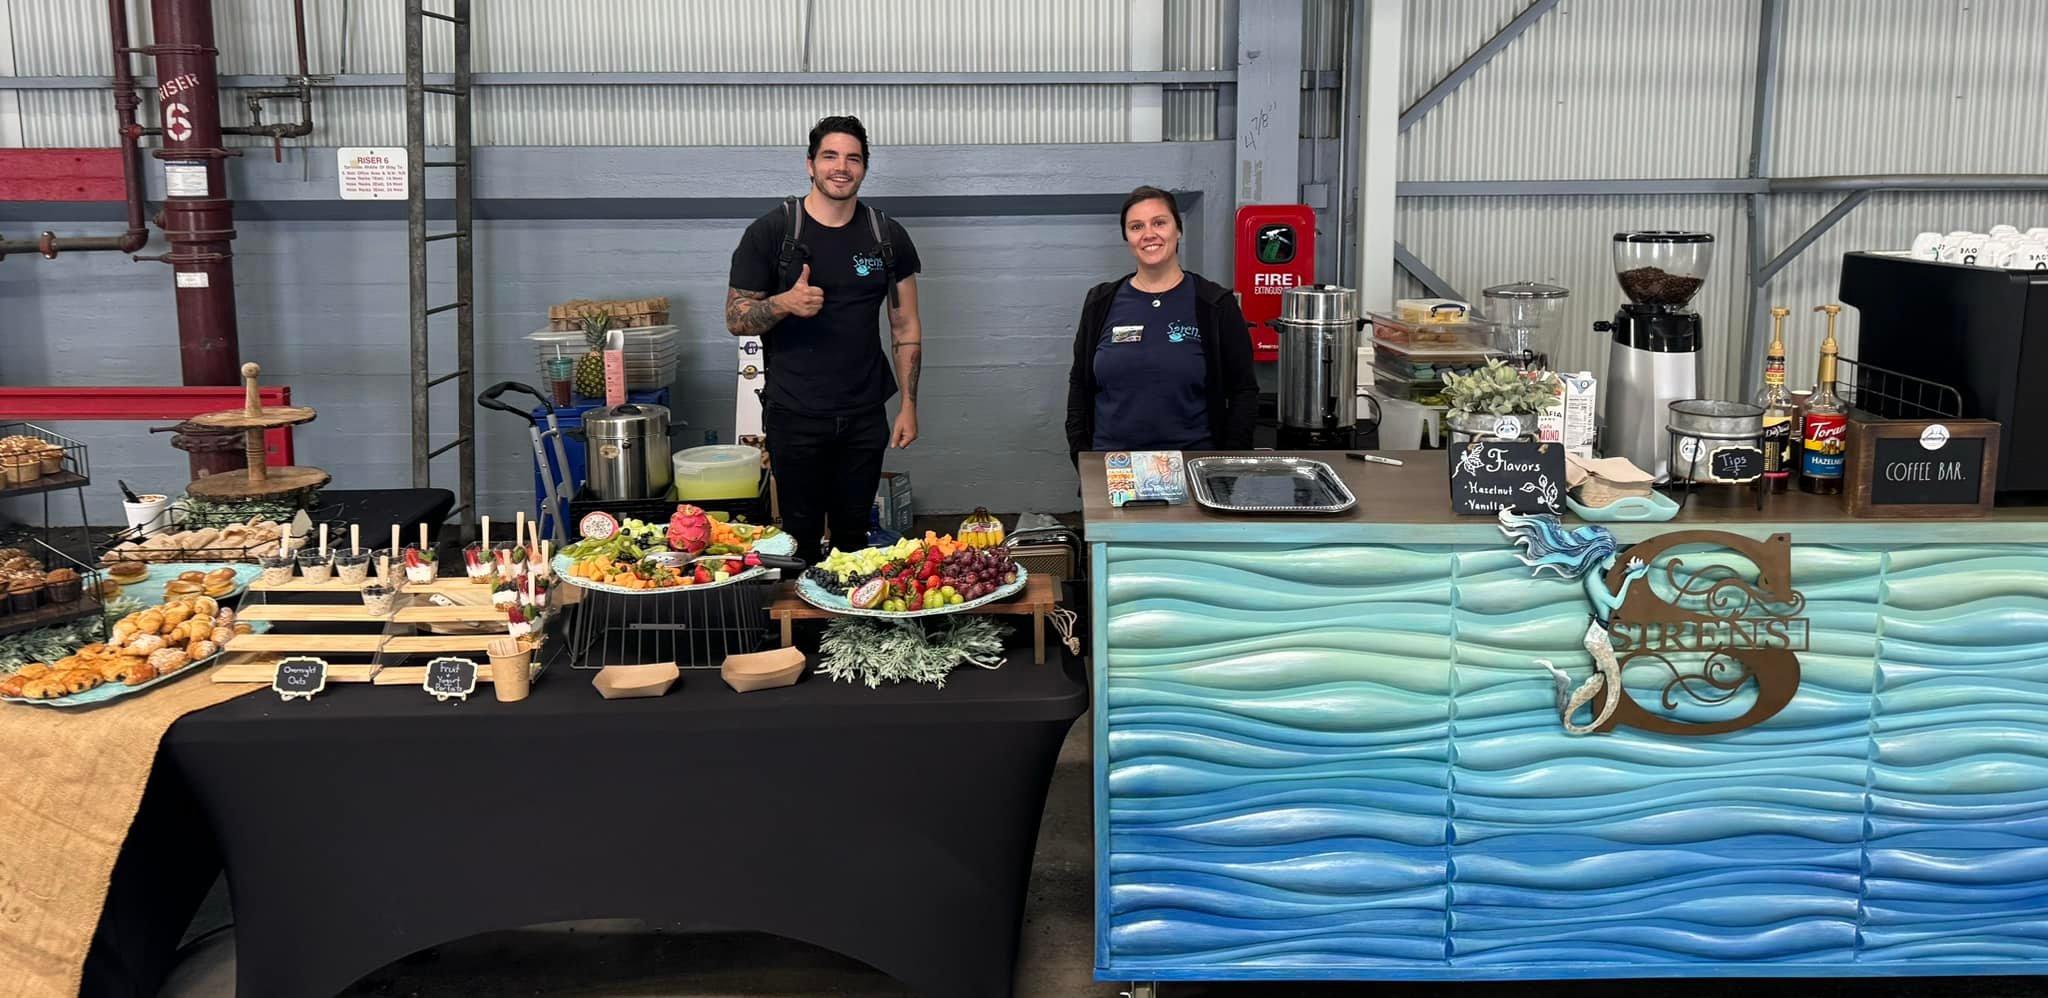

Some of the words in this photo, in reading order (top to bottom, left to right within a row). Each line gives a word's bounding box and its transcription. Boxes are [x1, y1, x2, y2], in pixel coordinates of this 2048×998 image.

[166, 103, 192, 141] 6
[357, 156, 382, 164] RISER
[384, 156, 390, 164] 6
[1254, 273, 1293, 286] FIRE
[1254, 286, 1292, 294] EXTINGUIS
[1539, 430, 1560, 441] MOND
[1485, 447, 1541, 473] Flavors
[1718, 452, 1747, 472] Tips
[1885, 462, 1932, 481] COFFEE
[1938, 462, 1966, 481] BAR.
[1608, 619, 1791, 651] SIRENS
